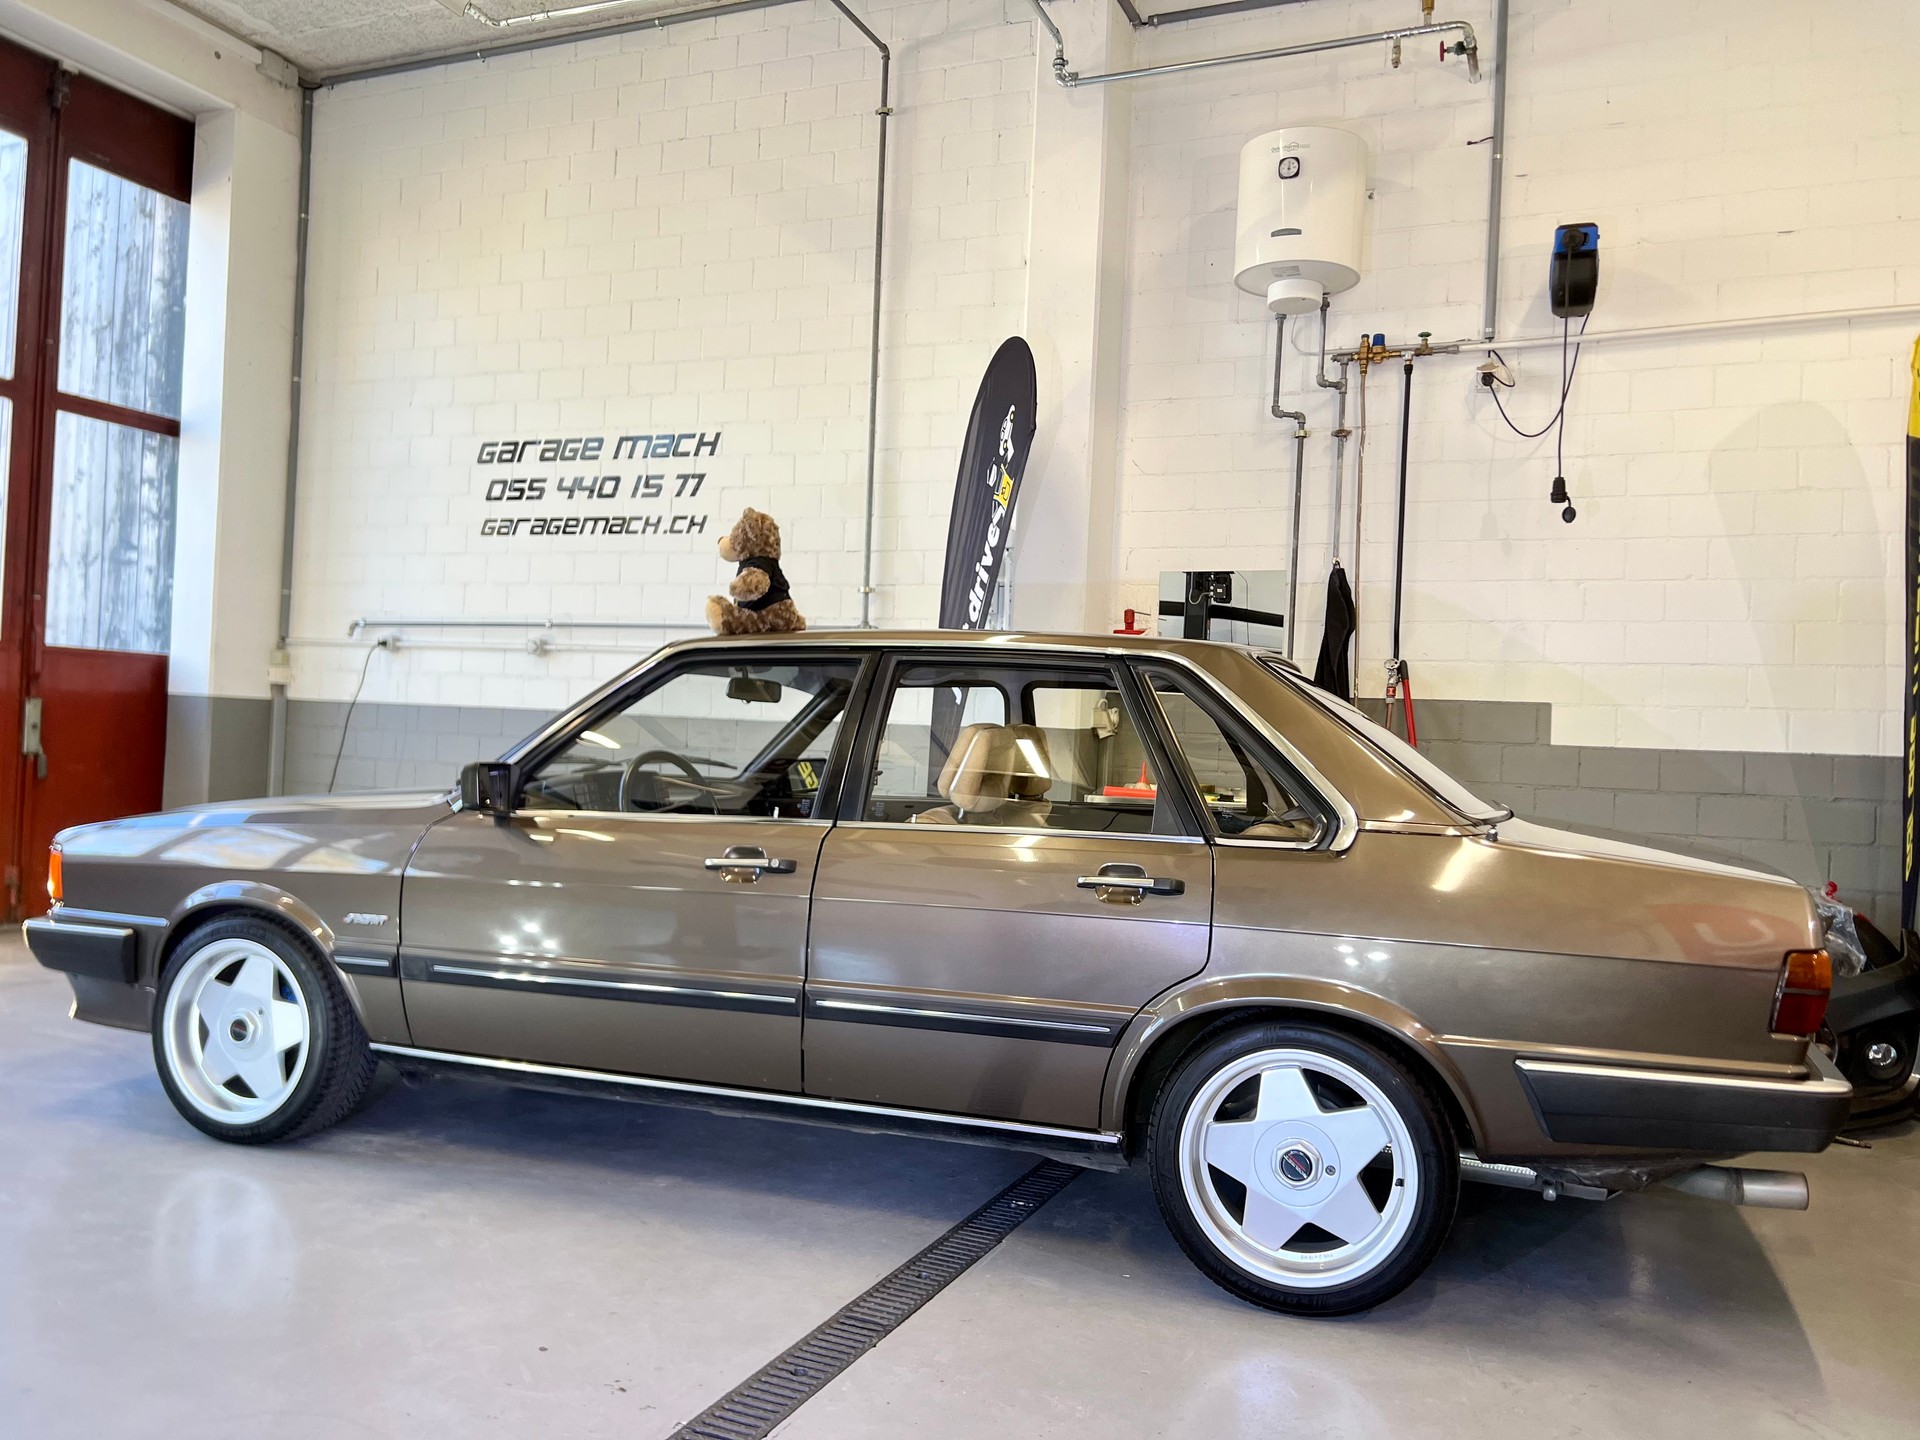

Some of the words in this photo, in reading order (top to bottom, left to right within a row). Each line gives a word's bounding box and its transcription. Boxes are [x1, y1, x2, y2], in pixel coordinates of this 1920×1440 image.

[485, 478, 548, 502] 055
[557, 475, 622, 500] 440
[631, 474, 665, 499] 15
[675, 473, 707, 498] 77
